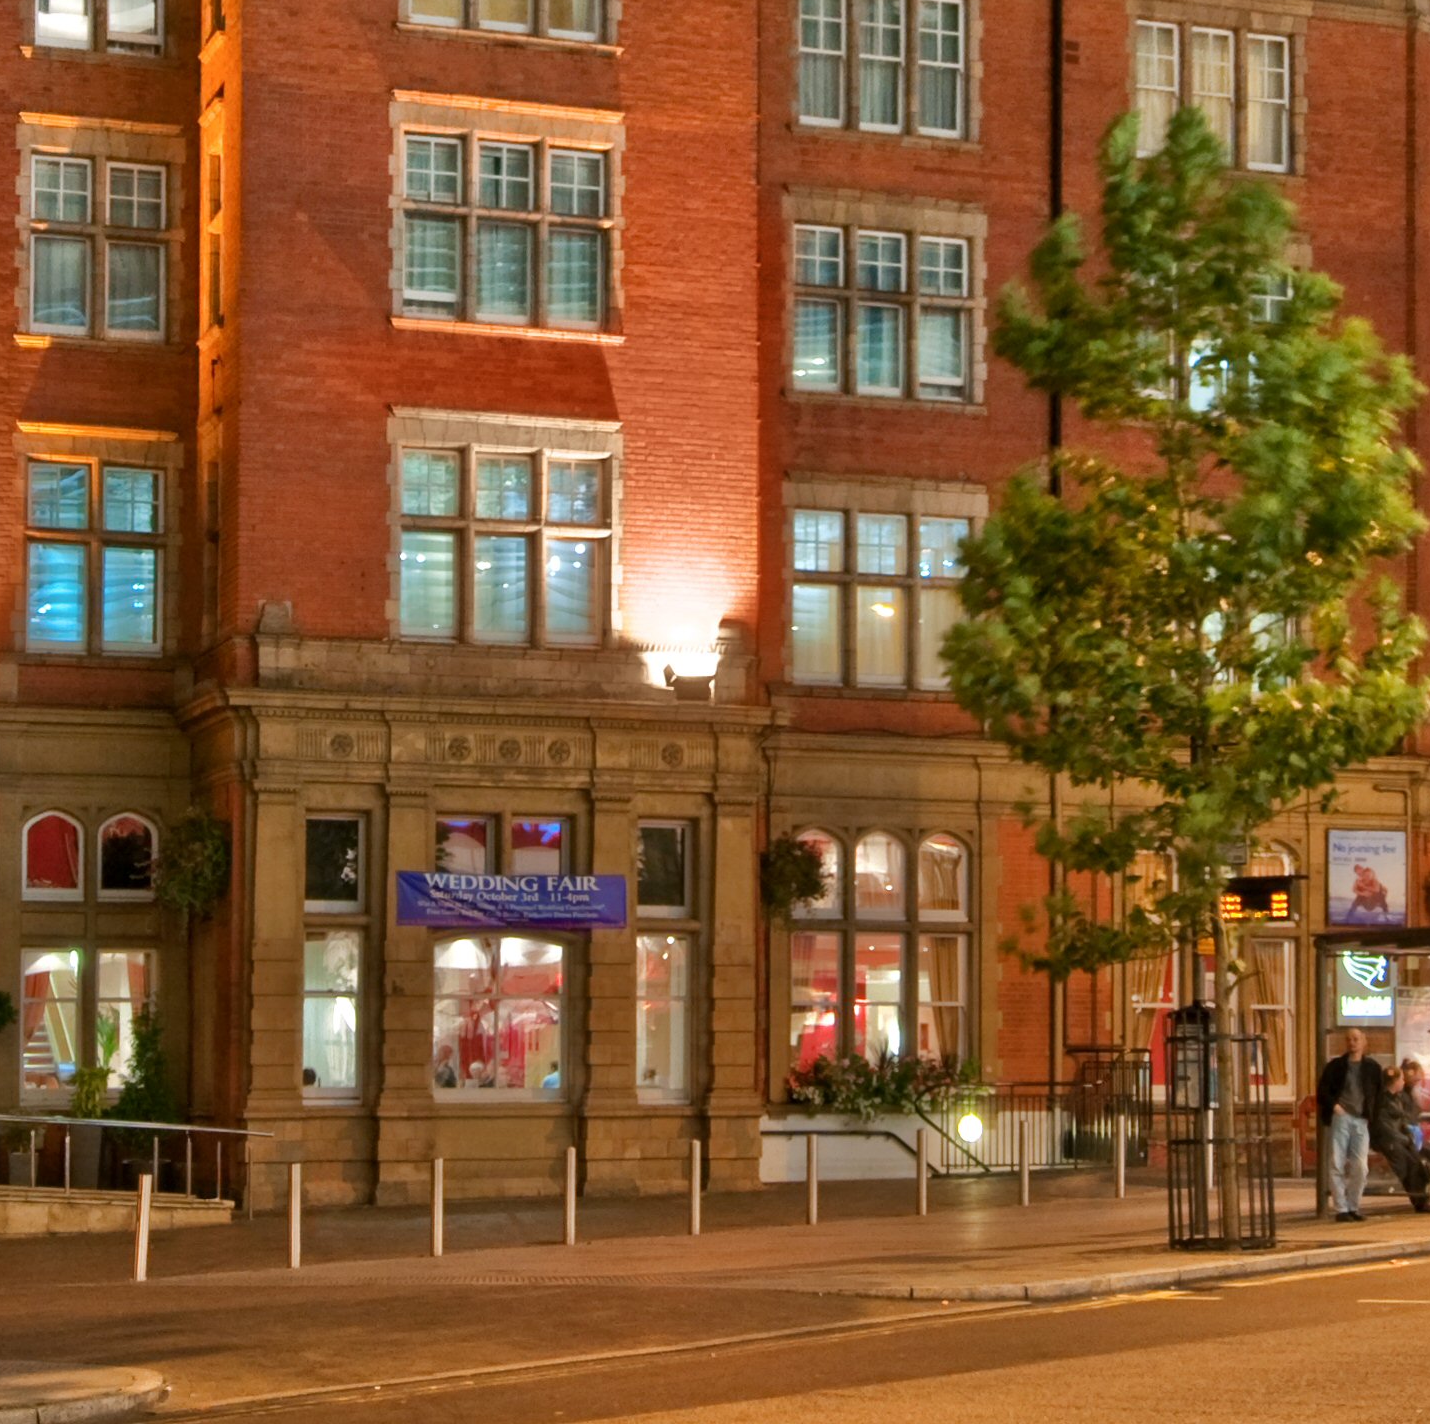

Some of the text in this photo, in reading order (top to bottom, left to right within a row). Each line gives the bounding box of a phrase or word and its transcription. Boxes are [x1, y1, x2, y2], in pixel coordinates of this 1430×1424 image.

[424, 873, 601, 892] WEDDING FAIR
[476, 892, 518, 902] October
[522, 892, 539, 902] 3rd
[551, 892, 590, 904] 11-4pm
